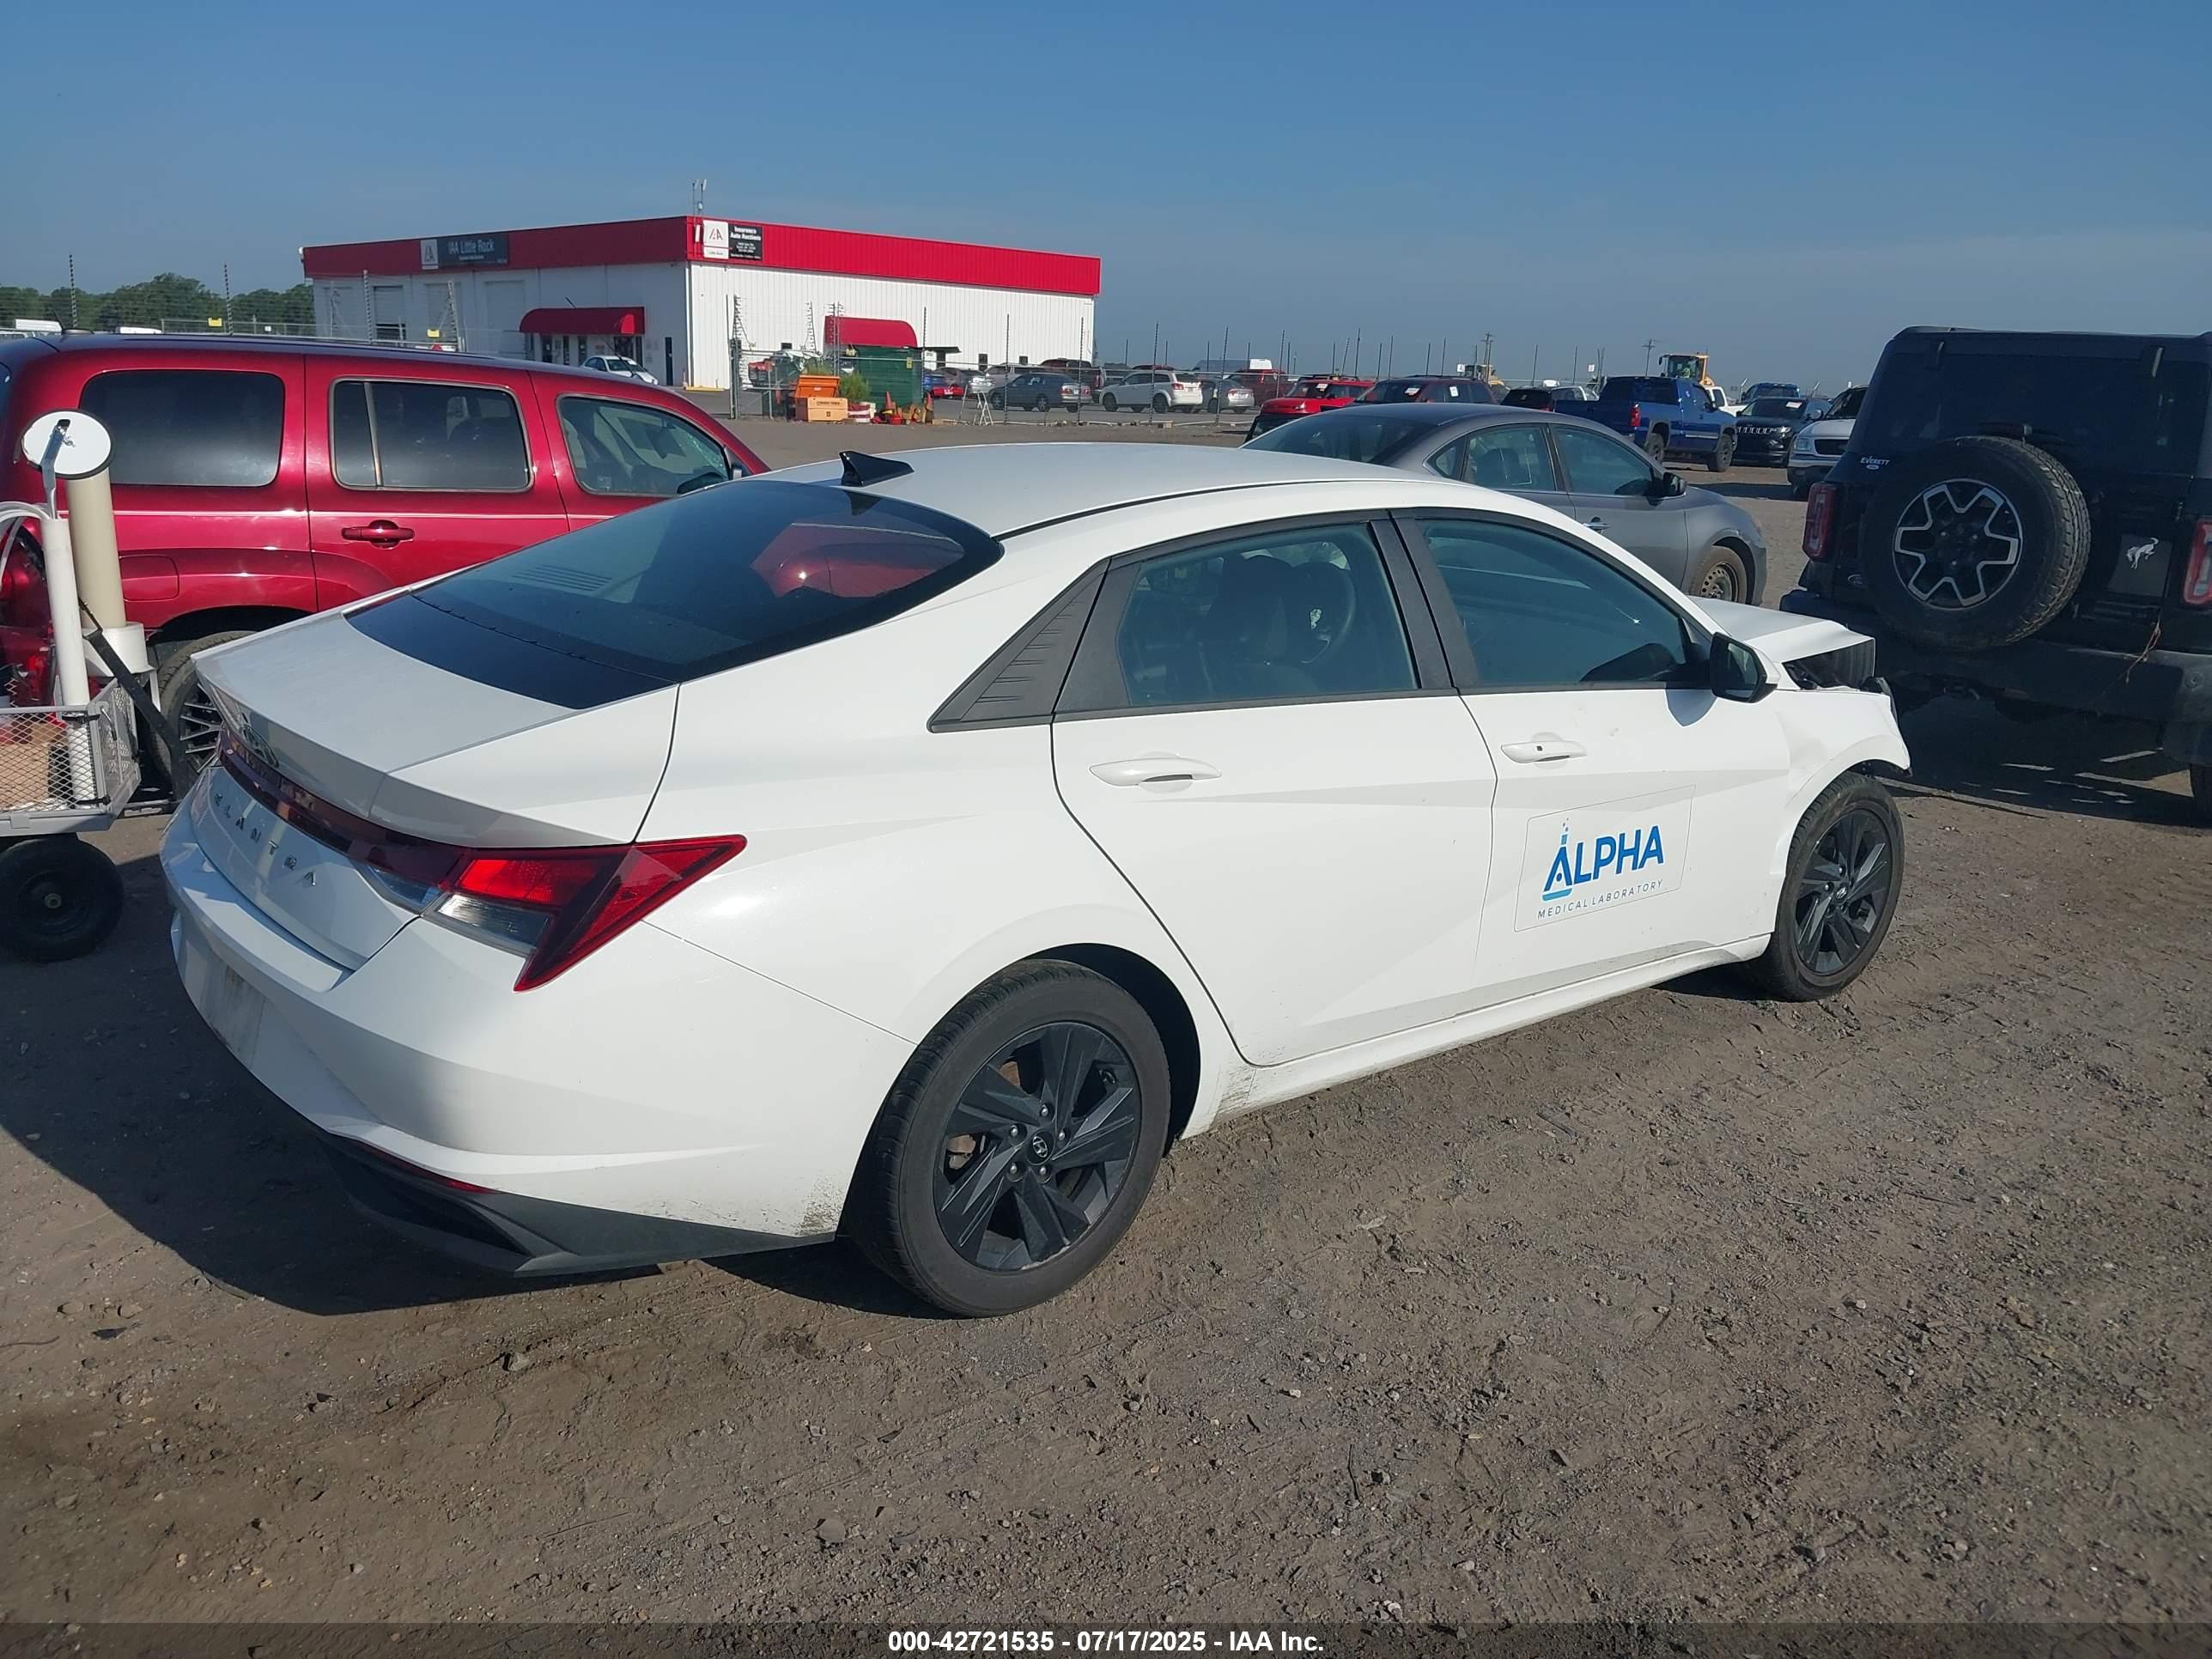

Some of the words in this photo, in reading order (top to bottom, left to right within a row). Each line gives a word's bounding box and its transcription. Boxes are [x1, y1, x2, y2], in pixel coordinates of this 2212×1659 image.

[215, 793, 317, 887] ELANTRA
[1543, 824, 1664, 893] ALPHA
[1537, 899, 1588, 920] MEDICAL
[1591, 878, 1663, 905] LABORATORY
